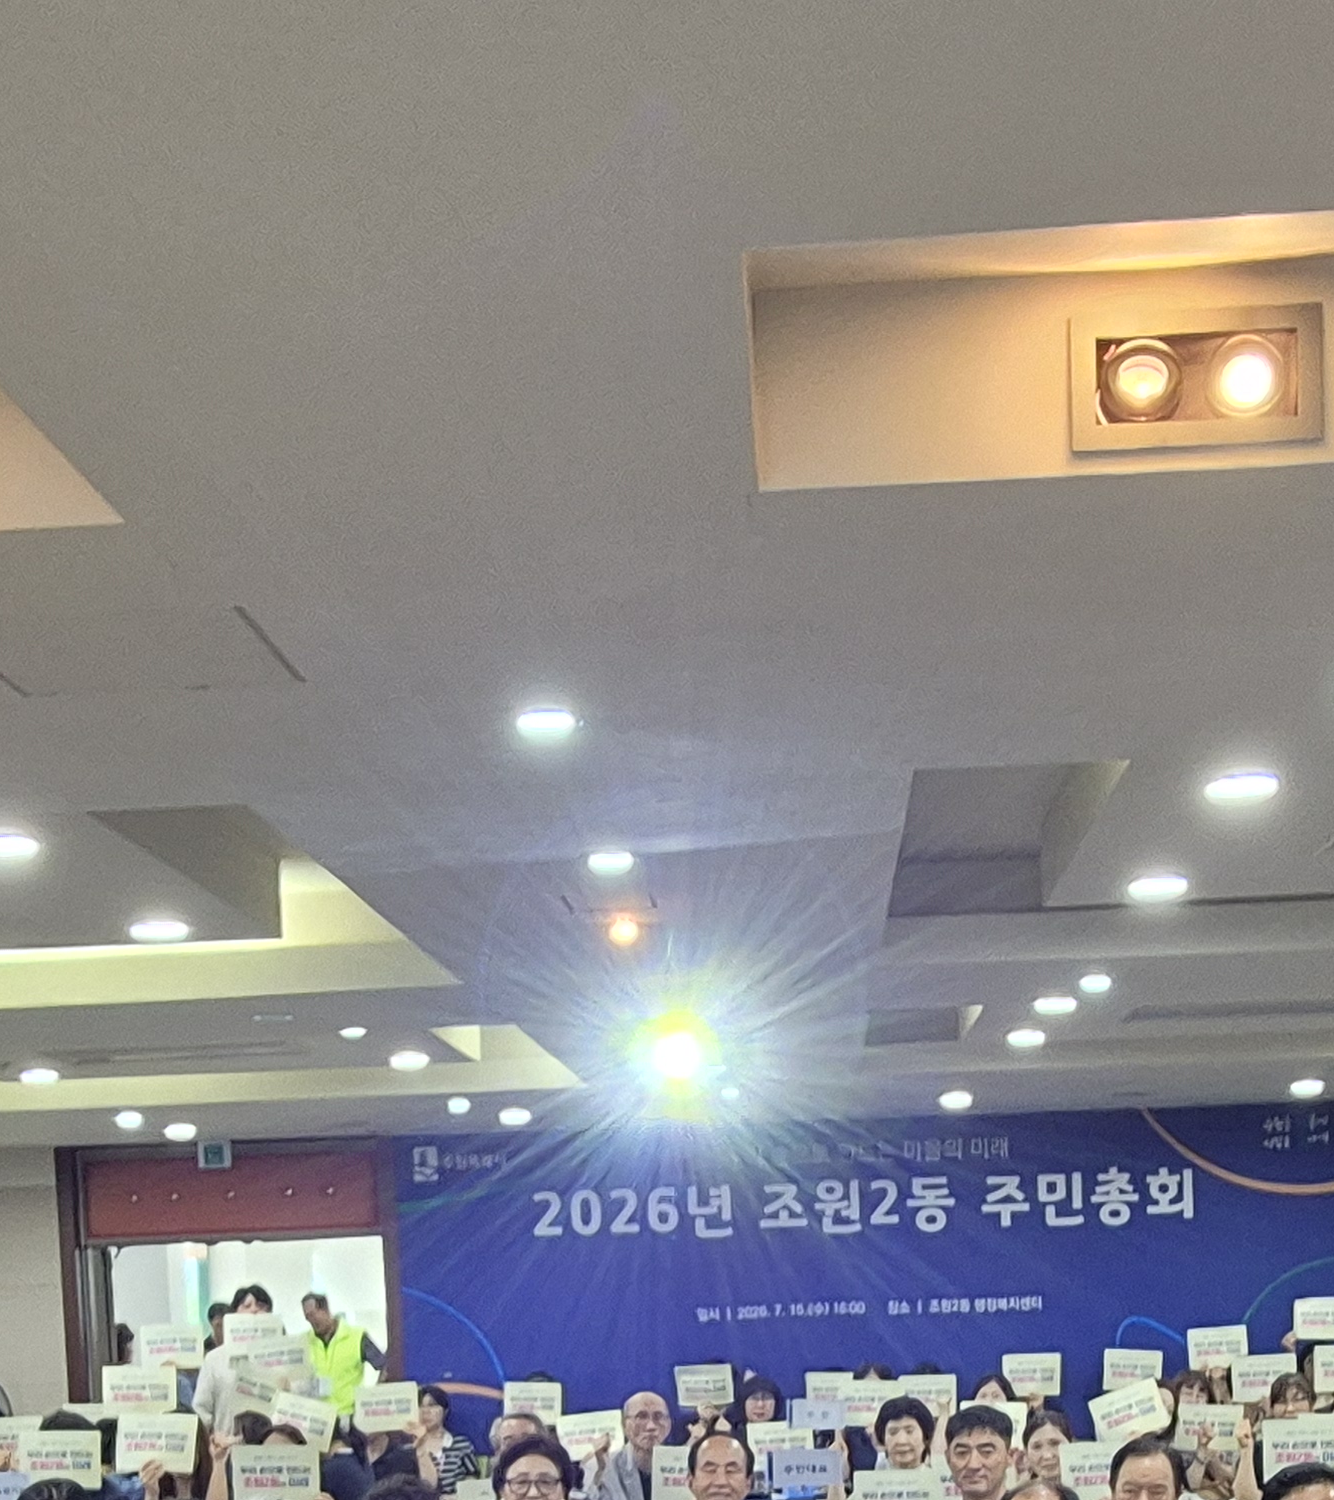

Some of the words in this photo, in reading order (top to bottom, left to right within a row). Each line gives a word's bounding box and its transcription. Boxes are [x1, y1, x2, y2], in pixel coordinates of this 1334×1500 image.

[533, 1183, 733, 1238] 2026년
[759, 1176, 956, 1235] 조원2동
[981, 1166, 1194, 1228] 주민총회
